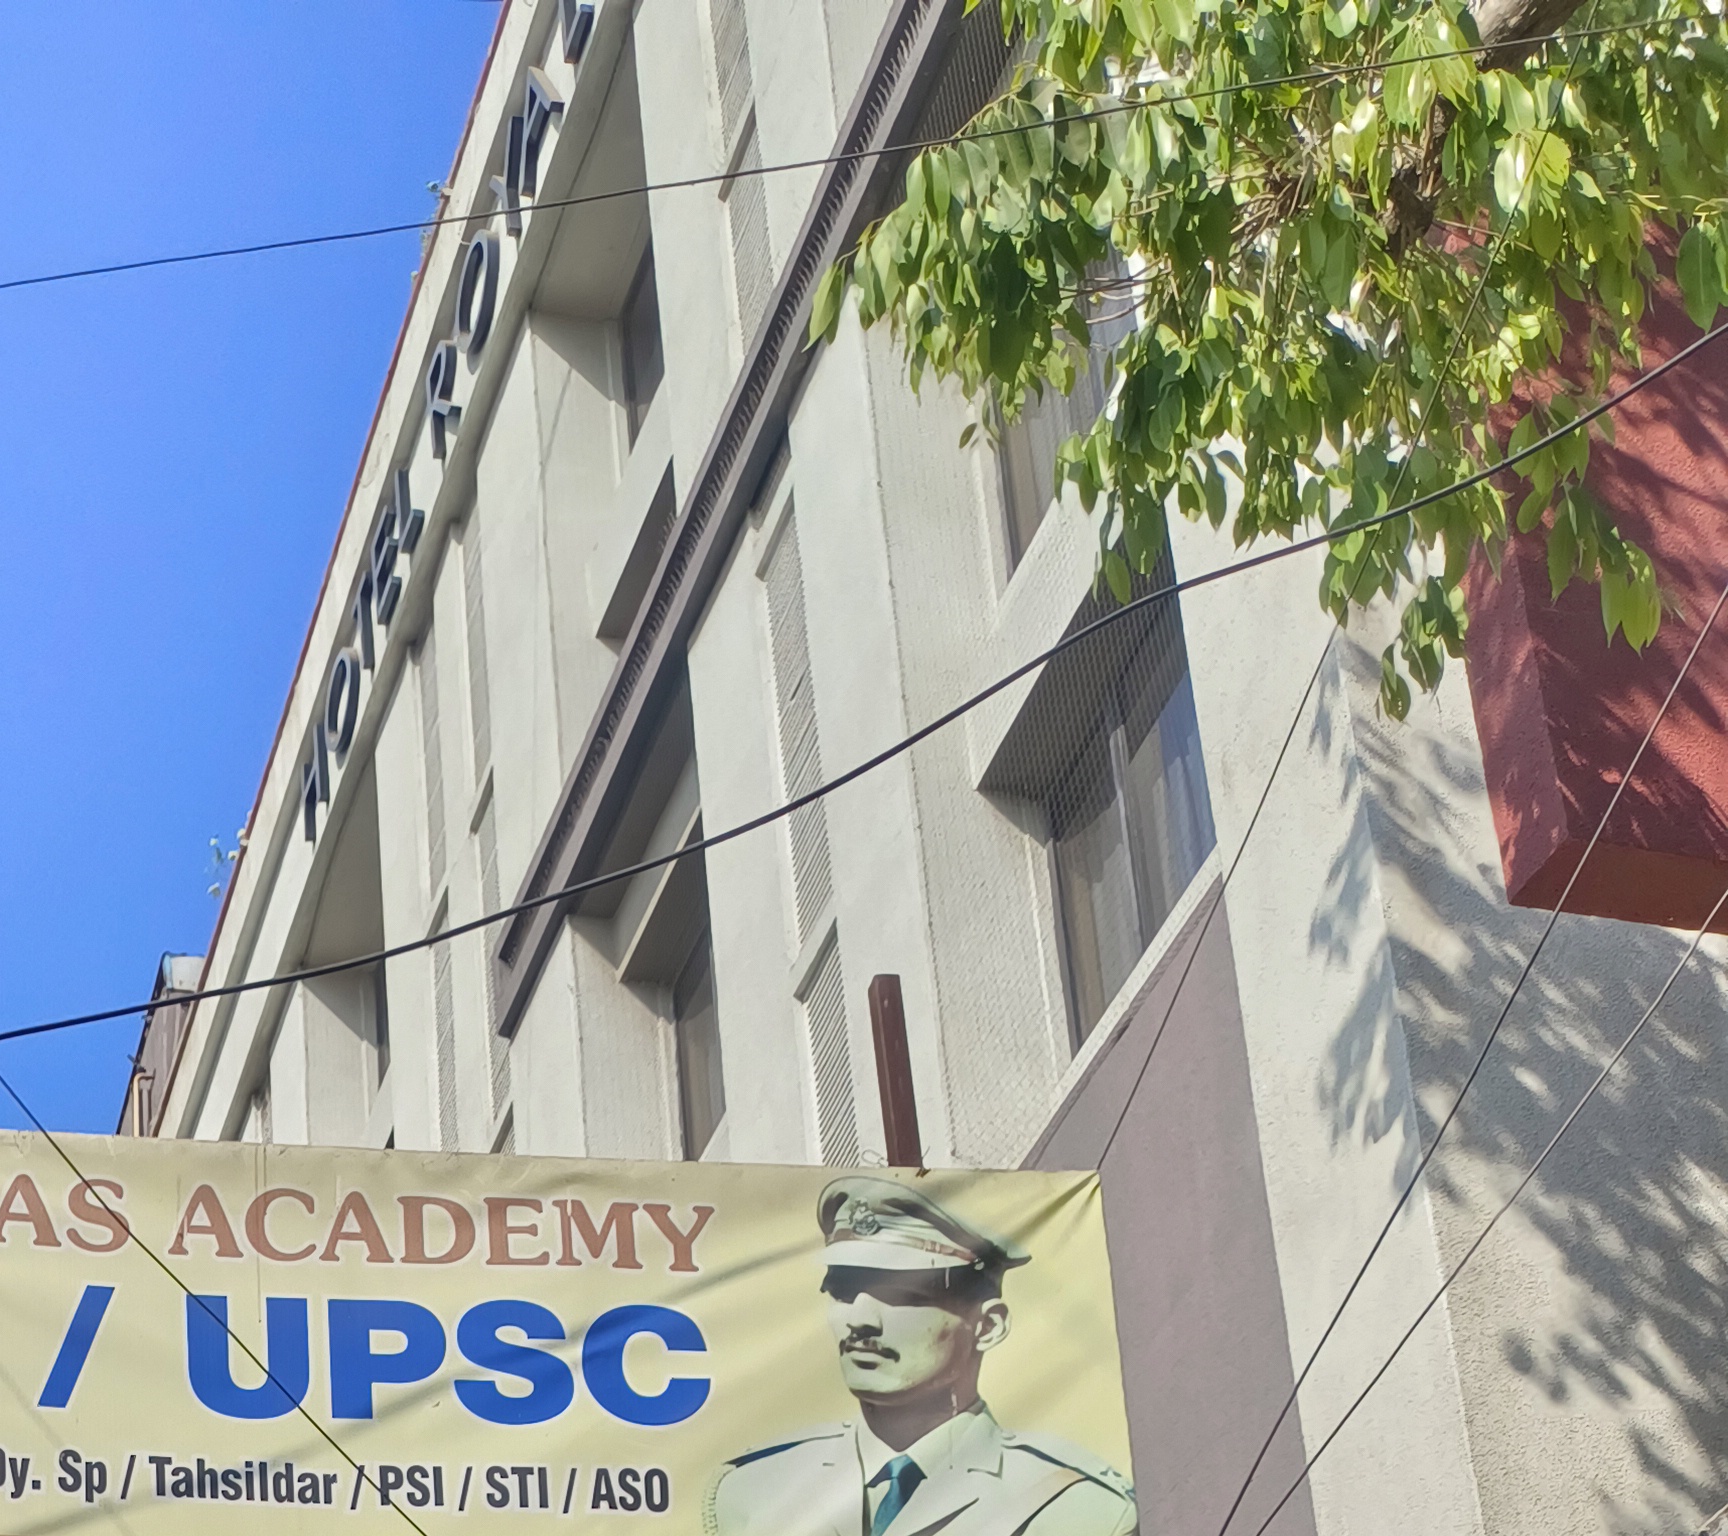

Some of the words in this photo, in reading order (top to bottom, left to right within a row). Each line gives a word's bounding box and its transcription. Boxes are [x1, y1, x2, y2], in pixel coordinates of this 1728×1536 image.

[301, 468, 425, 843] HOTEL
[168, 1185, 716, 1273] ACADEMY
[185, 1295, 712, 1427] UPSC
[59, 1450, 107, 1499] Sp
[149, 1456, 338, 1506] Tahsildar
[380, 1464, 444, 1508] PSI
[486, 1466, 548, 1509] STI
[592, 1469, 670, 1513] ASO
